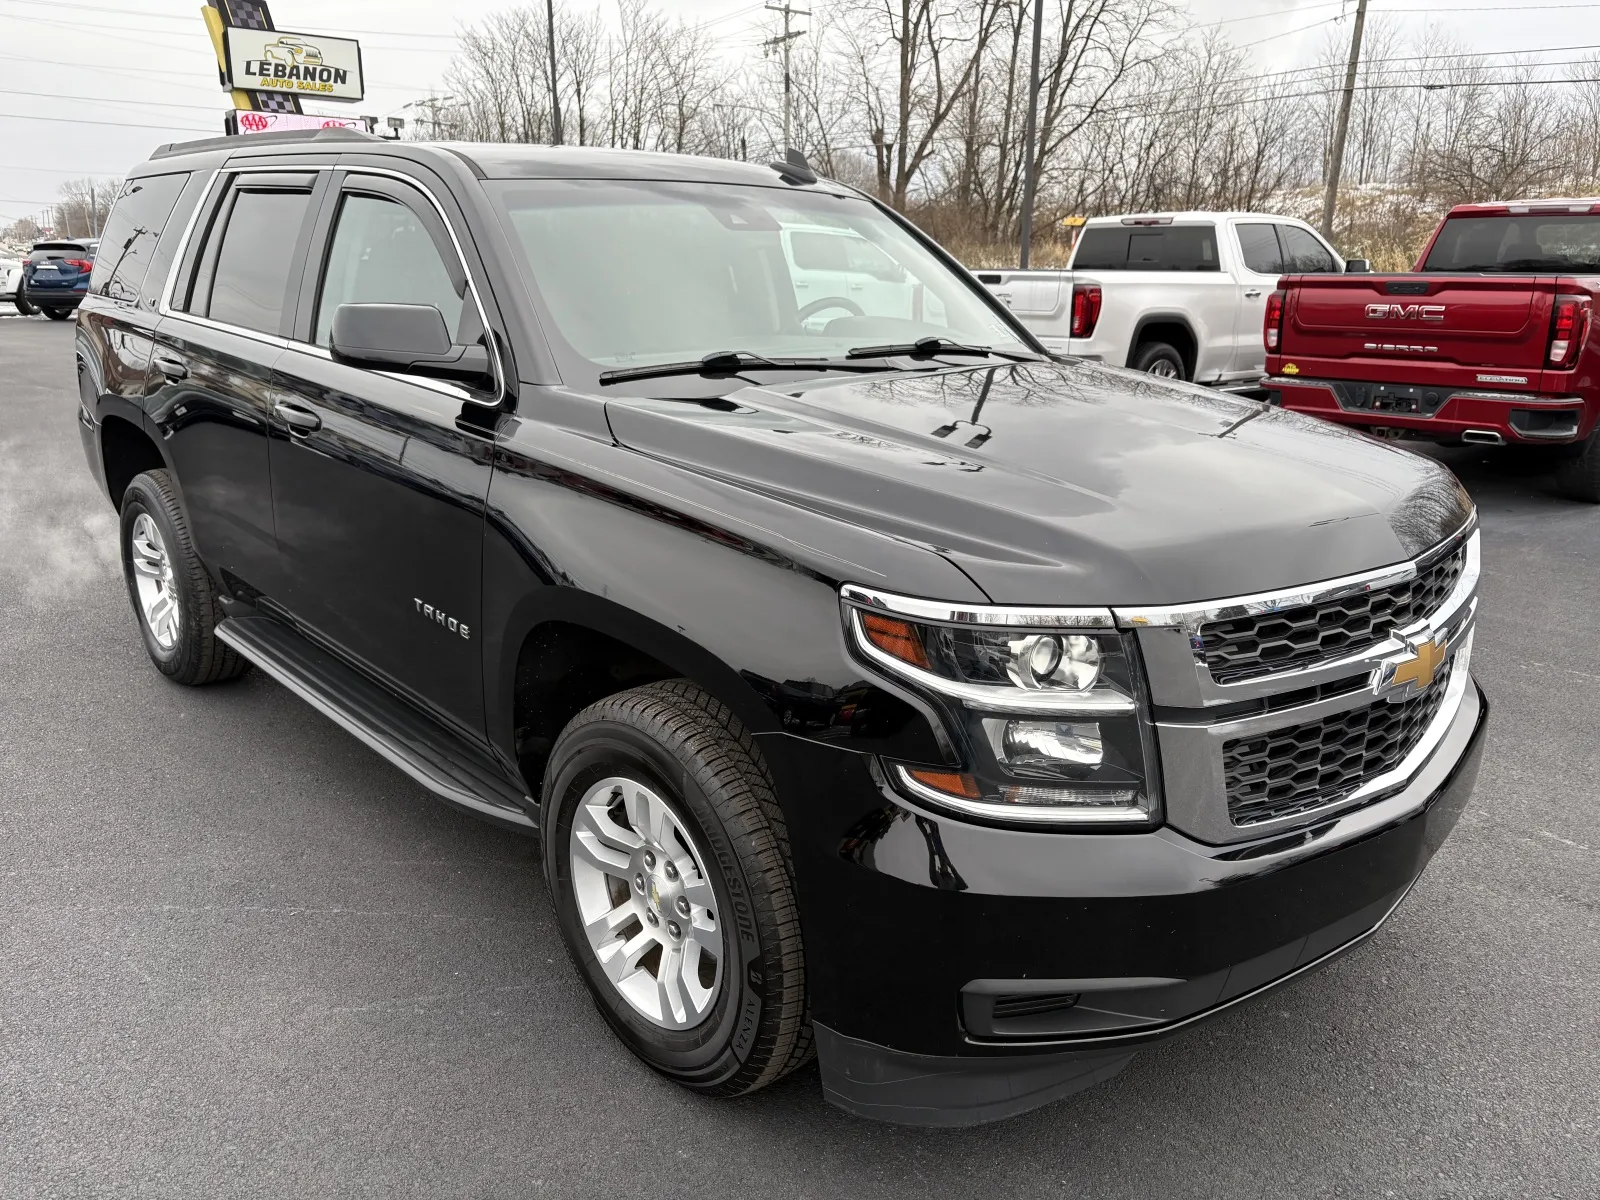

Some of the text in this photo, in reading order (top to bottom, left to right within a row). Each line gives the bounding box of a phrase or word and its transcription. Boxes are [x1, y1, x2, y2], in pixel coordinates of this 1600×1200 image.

[245, 60, 347, 84] LEBANON
[260, 77, 334, 93] AUTO SALES
[241, 114, 268, 131] AAA
[1365, 304, 1446, 320] GMC
[1364, 343, 1438, 352] SIERRA
[413, 597, 470, 640] TAHOE
[736, 997, 756, 1050] ALENZA
